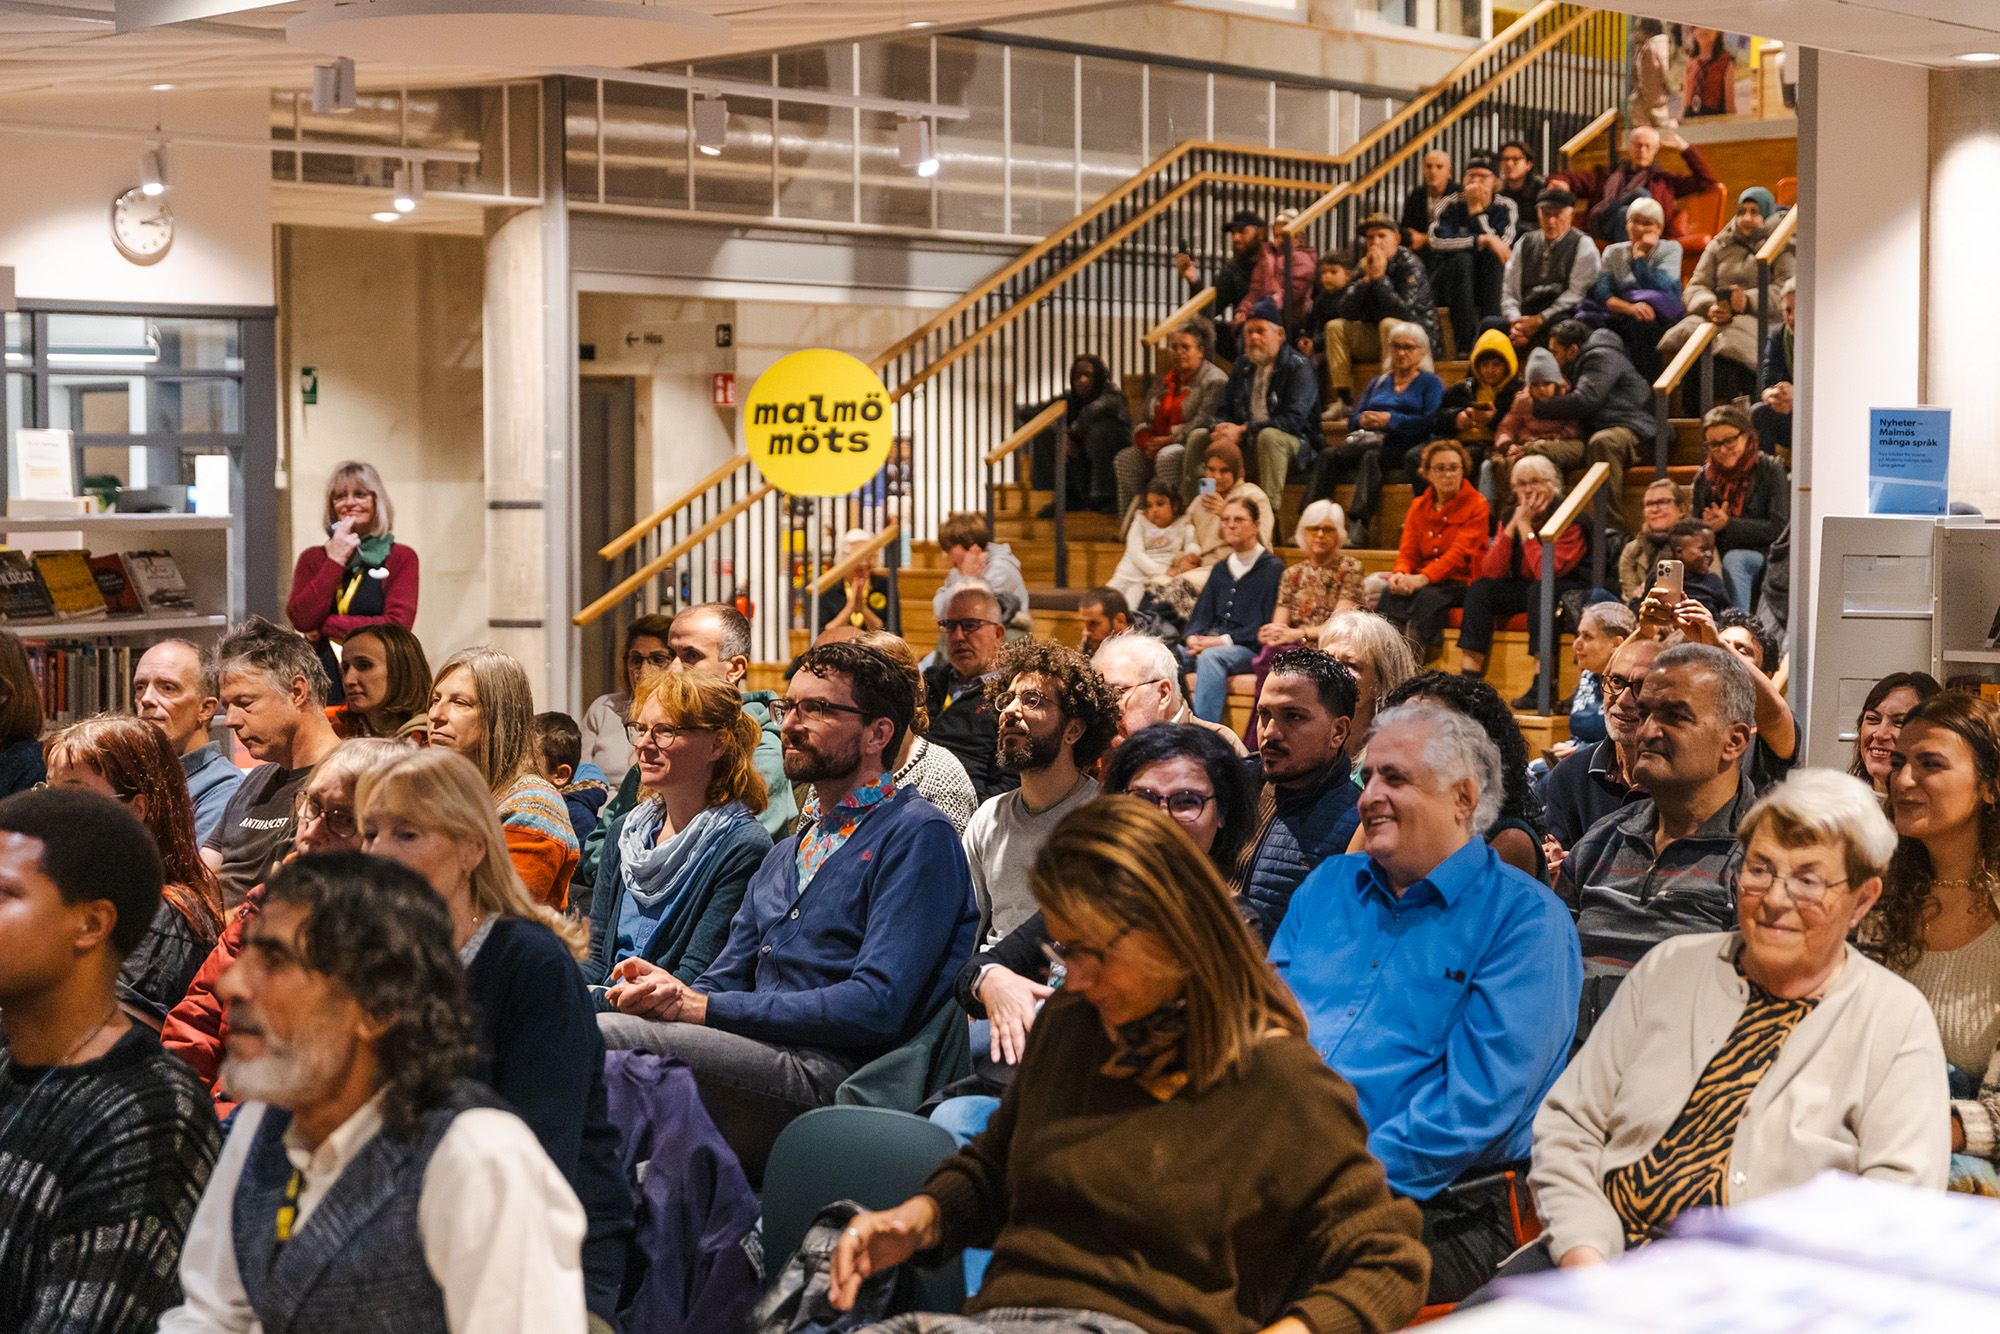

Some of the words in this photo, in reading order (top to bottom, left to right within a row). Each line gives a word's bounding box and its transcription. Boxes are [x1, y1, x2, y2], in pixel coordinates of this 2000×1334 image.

[754, 393, 883, 424] malmö
[1879, 418, 1917, 428] Nyheter
[1879, 428, 1915, 437] Malmös
[769, 426, 869, 455] möts
[1879, 438, 1911, 448] många
[1912, 438, 1938, 448] språk
